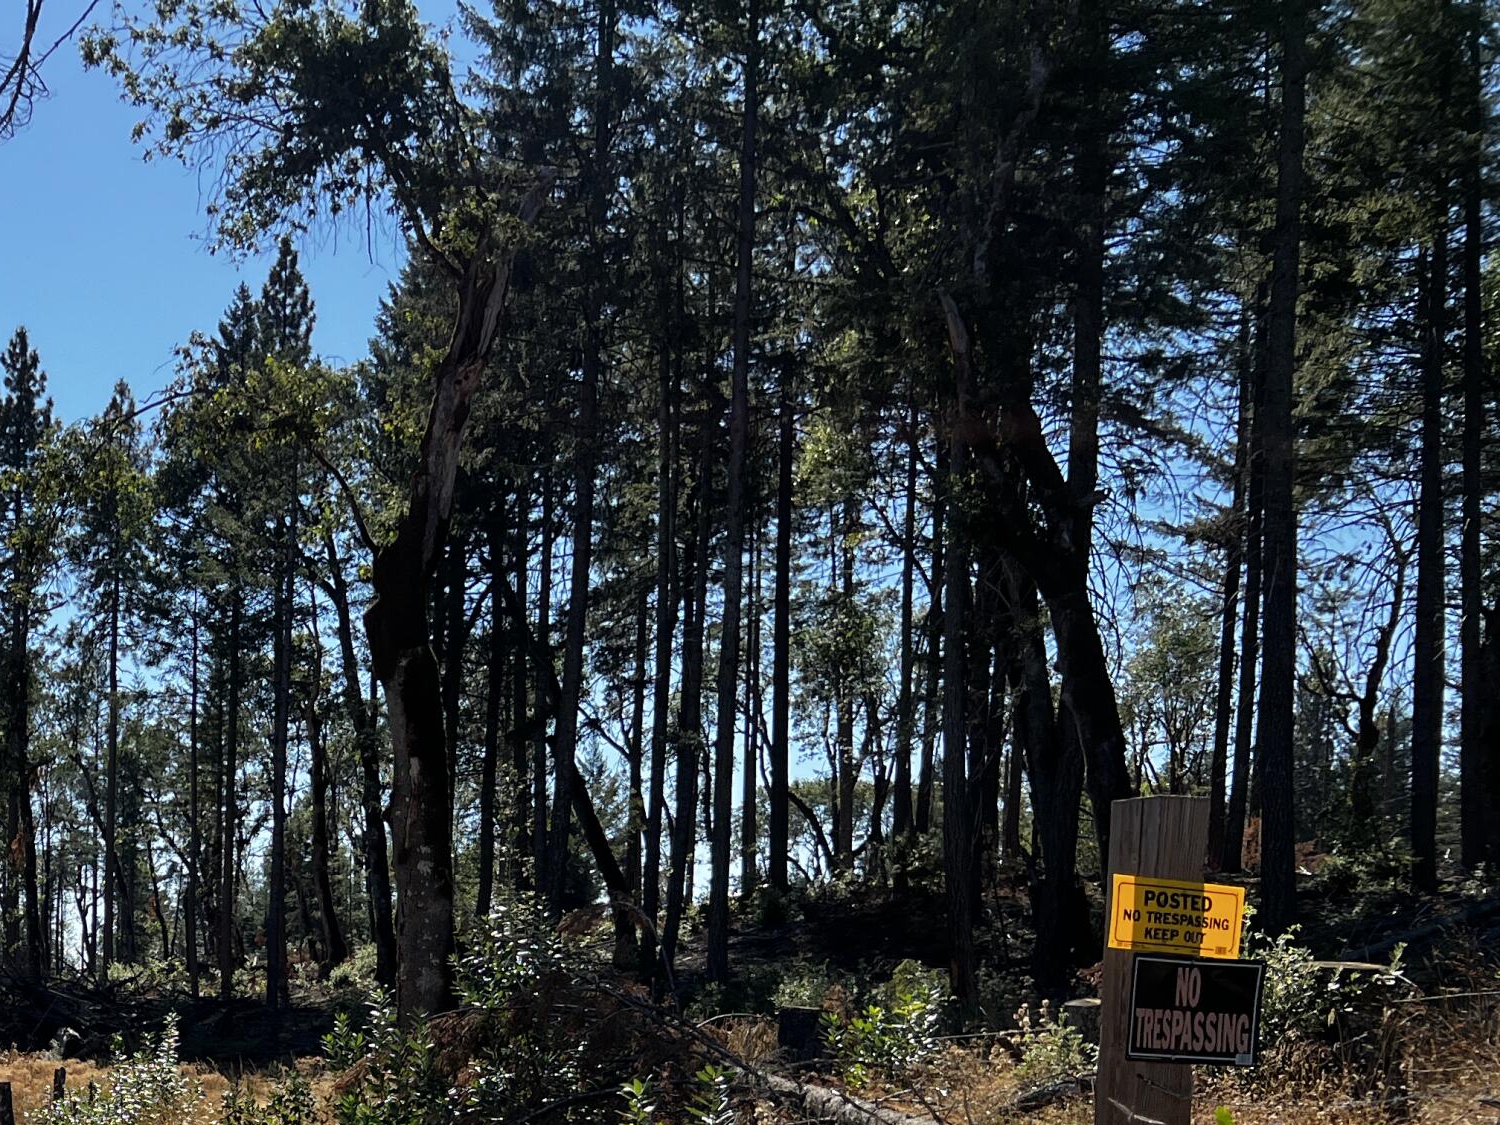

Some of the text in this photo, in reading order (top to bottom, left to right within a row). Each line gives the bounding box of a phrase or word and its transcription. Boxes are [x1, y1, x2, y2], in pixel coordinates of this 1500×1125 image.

[1144, 890, 1212, 913] POSTED
[1123, 909, 1229, 931] NO TRESPASSING
[1144, 927, 1207, 945] KEEP OUT
[1175, 967, 1201, 1007] NO
[1135, 1007, 1249, 1053] TRESPASSING
